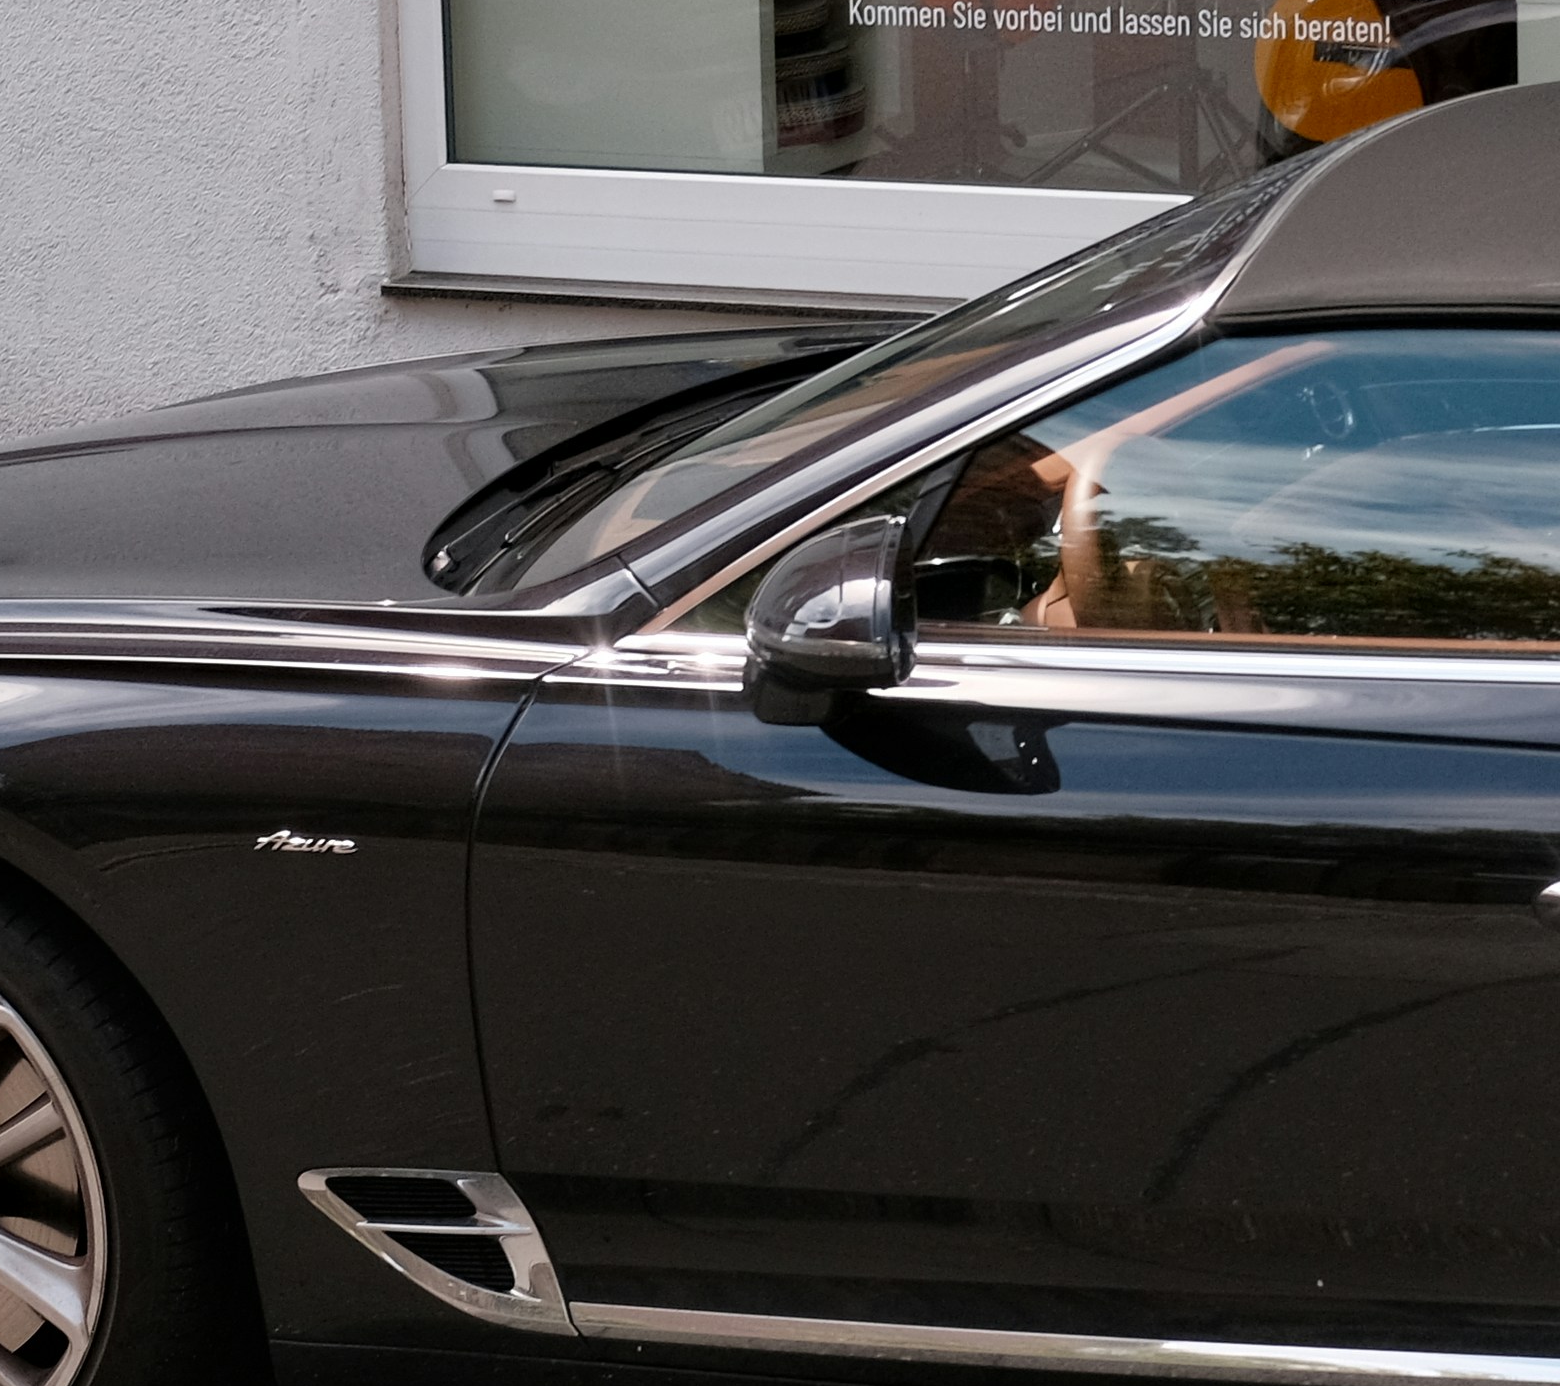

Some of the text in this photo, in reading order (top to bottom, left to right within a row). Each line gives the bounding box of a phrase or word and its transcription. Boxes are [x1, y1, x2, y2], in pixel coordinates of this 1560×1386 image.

[952, 0, 987, 30] Sie
[993, 3, 1063, 32] vorbei
[1070, 5, 1112, 34] und
[1119, 6, 1190, 37] lassen
[1198, 9, 1232, 38] Sie
[1239, 11, 1286, 40] sich
[1294, 13, 1391, 44] beraten!
[254, 830, 359, 854] Azure
